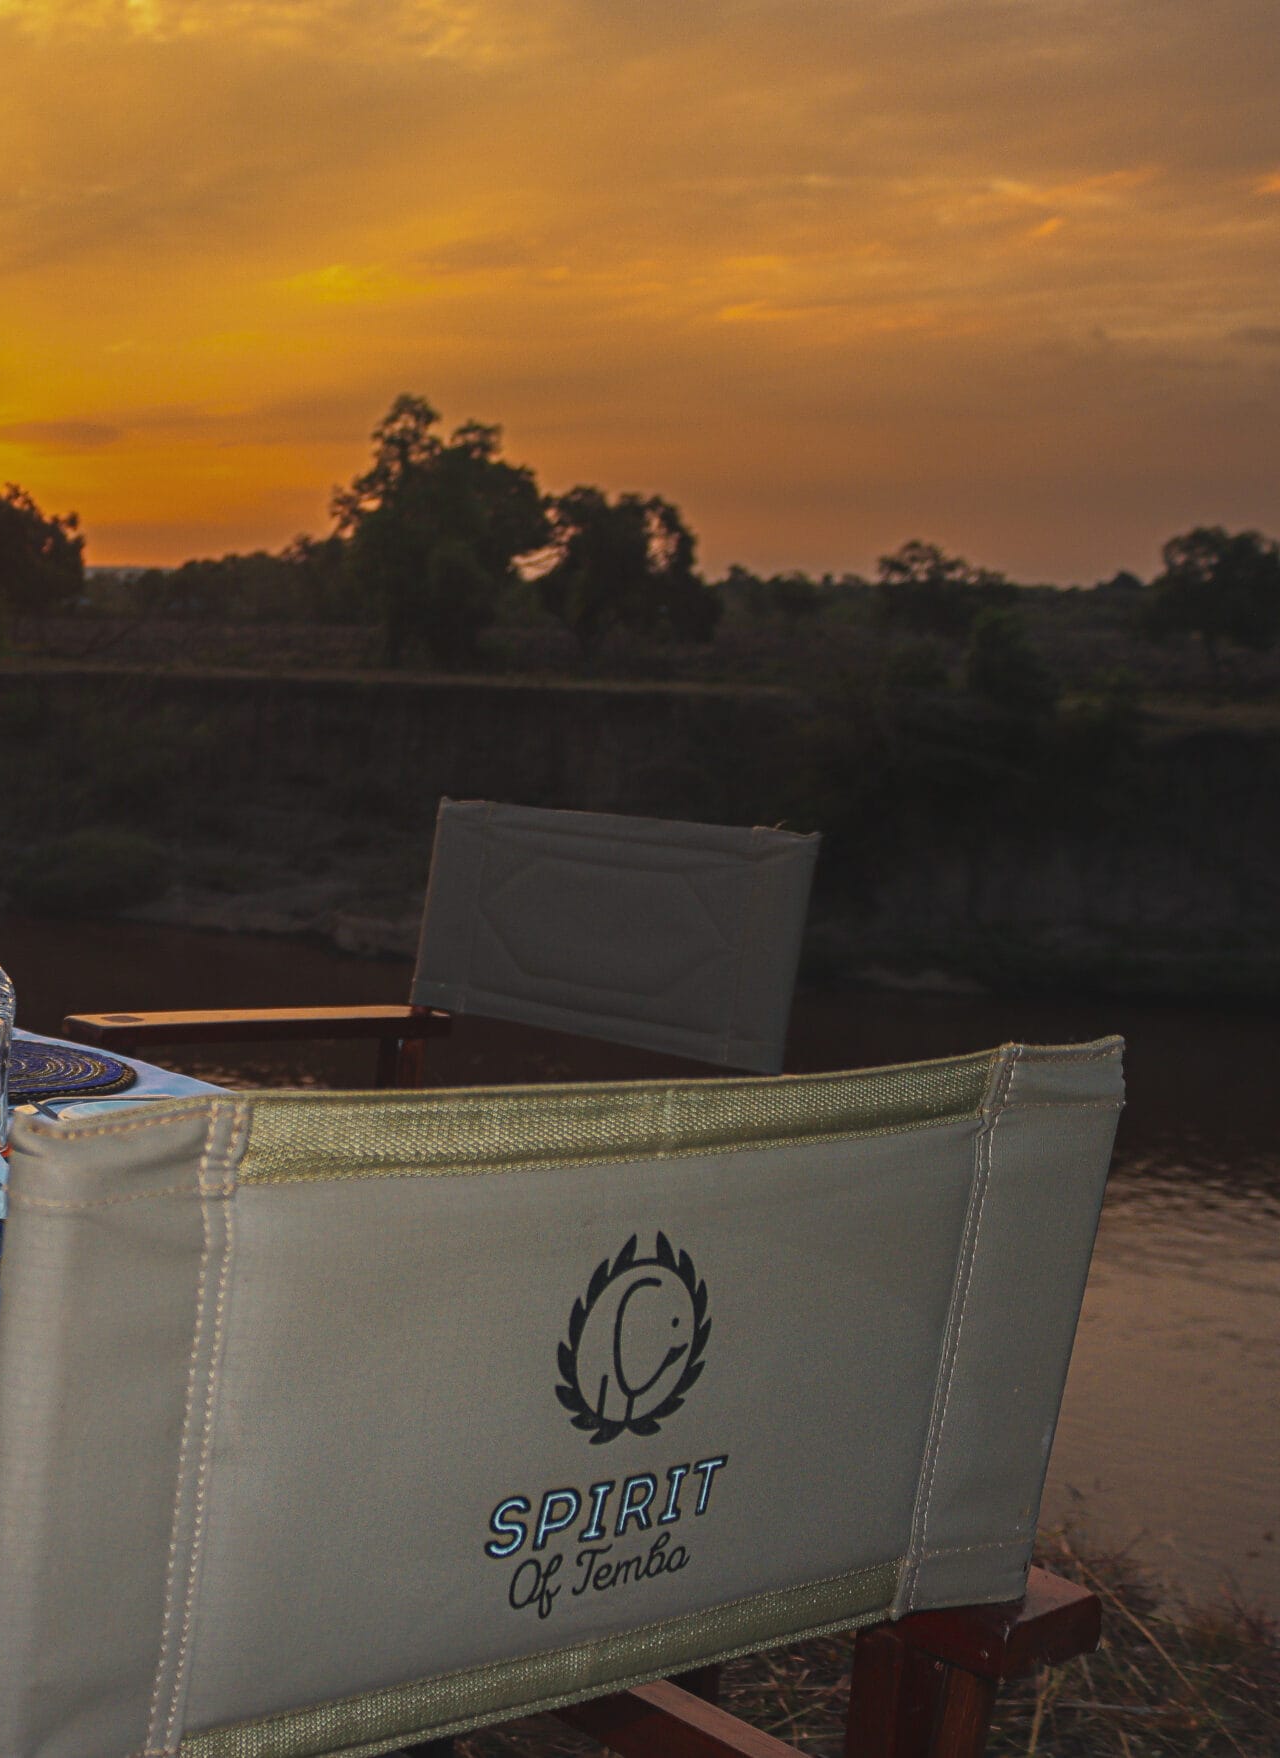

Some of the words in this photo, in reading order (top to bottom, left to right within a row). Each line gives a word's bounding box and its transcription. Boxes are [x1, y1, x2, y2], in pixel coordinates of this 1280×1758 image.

[484, 1454, 730, 1560] SPIRIT
[508, 1553, 564, 1620] Of
[571, 1531, 692, 1596] Tembo
